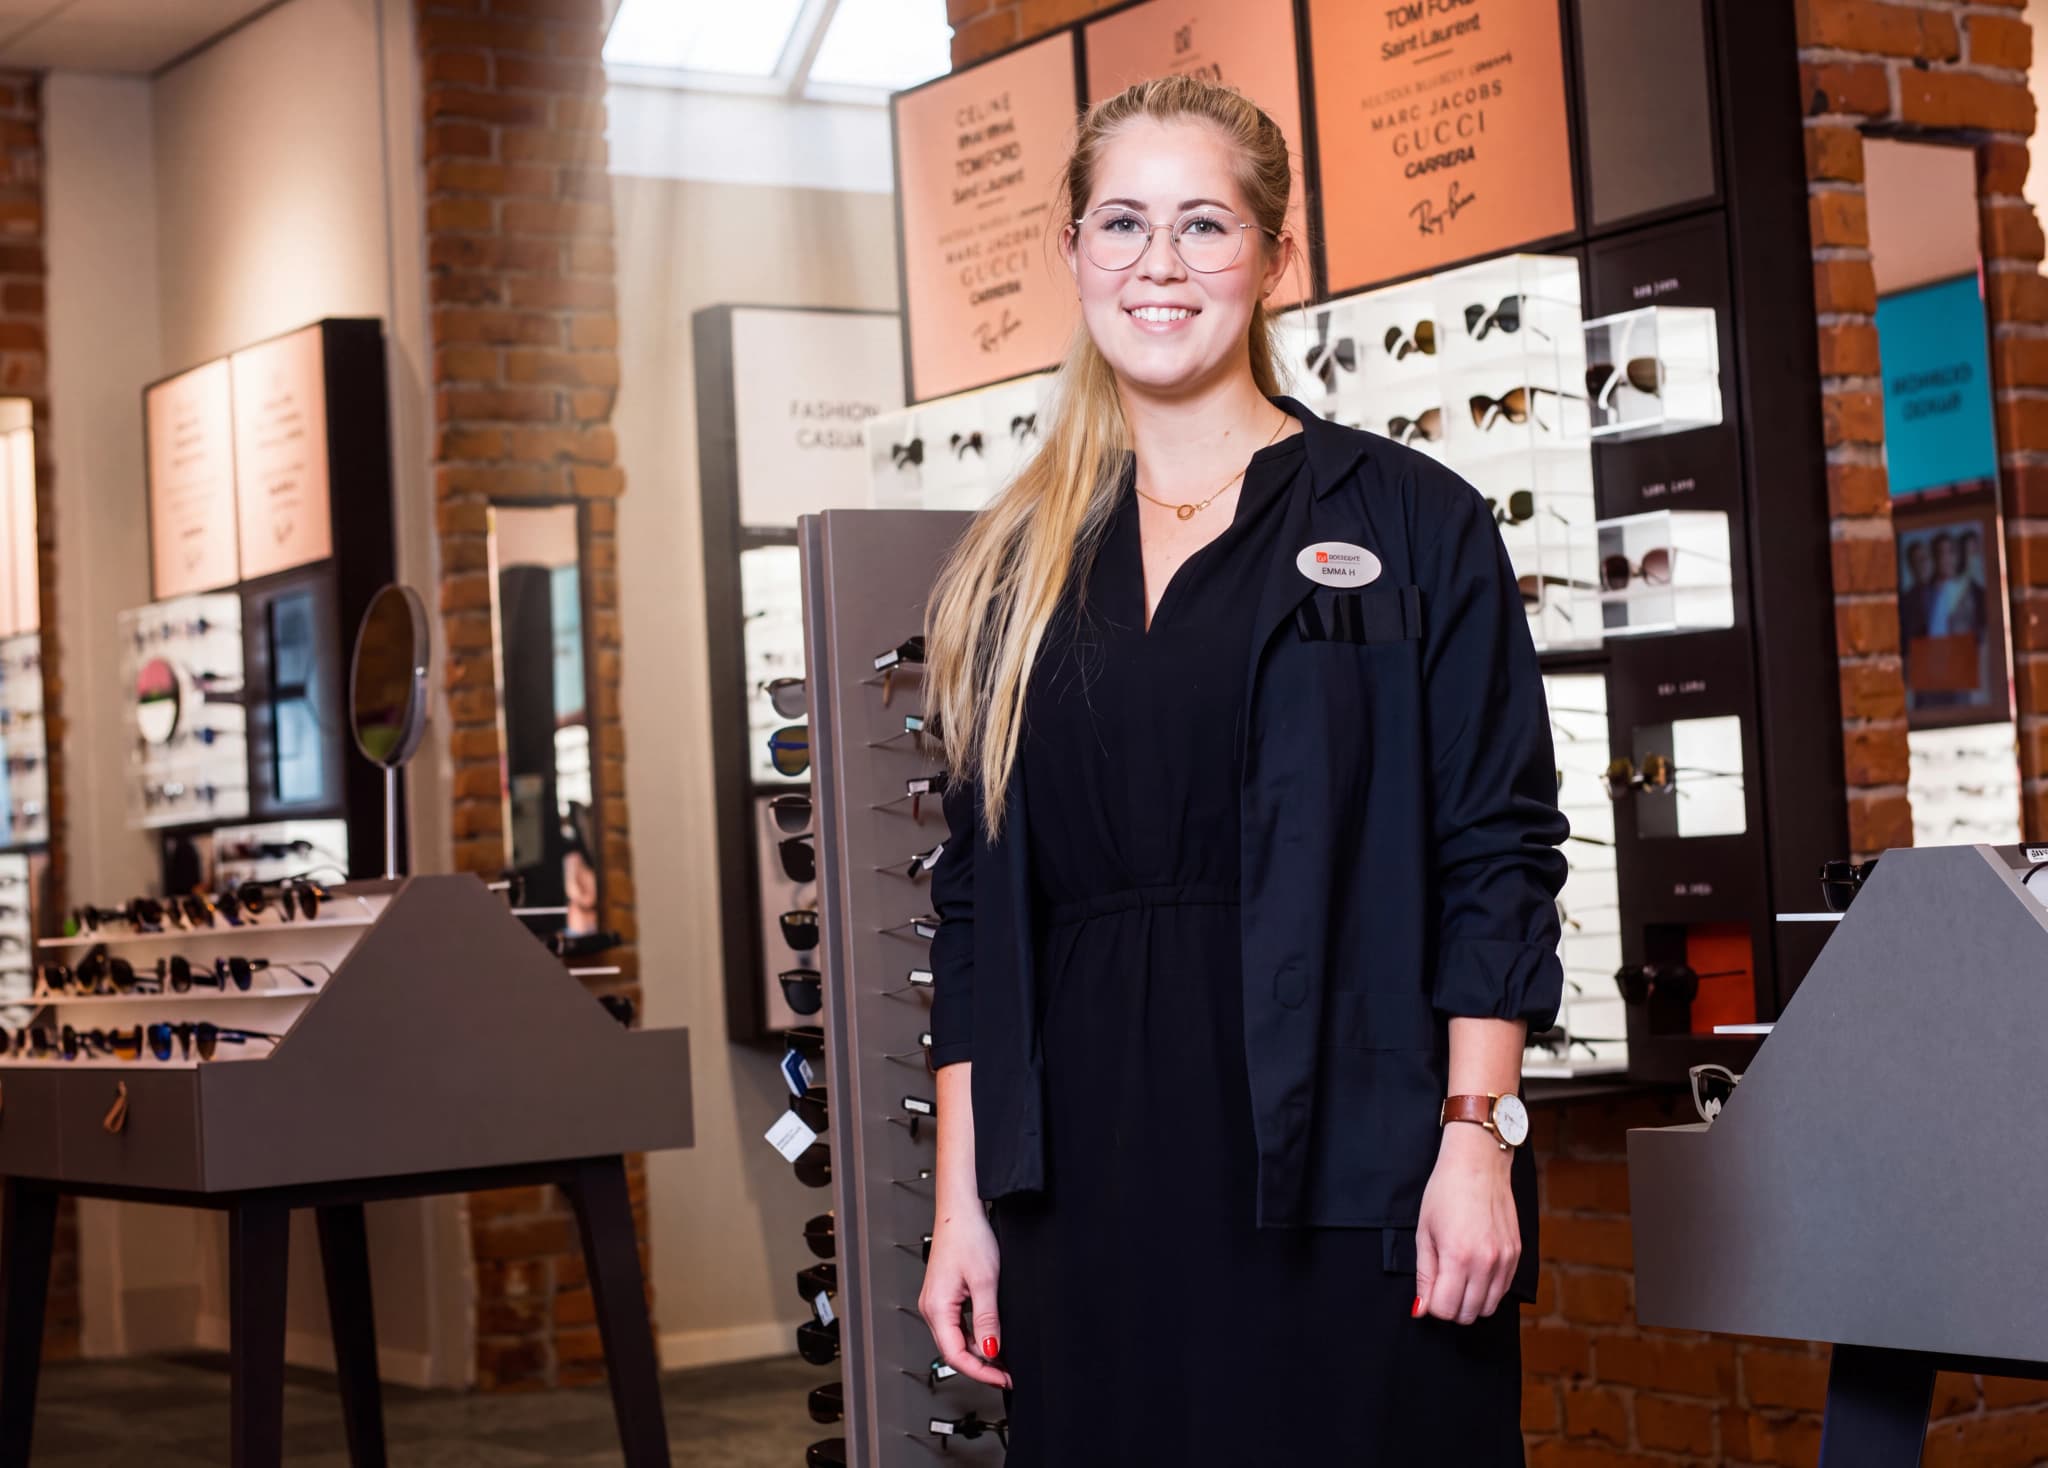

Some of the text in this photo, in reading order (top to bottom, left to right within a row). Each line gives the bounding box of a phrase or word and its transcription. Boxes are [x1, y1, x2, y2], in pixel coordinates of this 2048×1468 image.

[1385, 0, 1424, 30] TOM
[1381, 13, 1480, 61] Saint Laurent
[1371, 104, 1421, 130] MARC
[1430, 79, 1502, 116] JACOBS
[1393, 110, 1485, 157] GUCCI
[1404, 146, 1475, 179] CARRERA
[961, 249, 1029, 287] GUCCI
[790, 400, 880, 421] FASHION
[796, 427, 865, 449] CASUA
[1321, 566, 1356, 577] EMMA H
